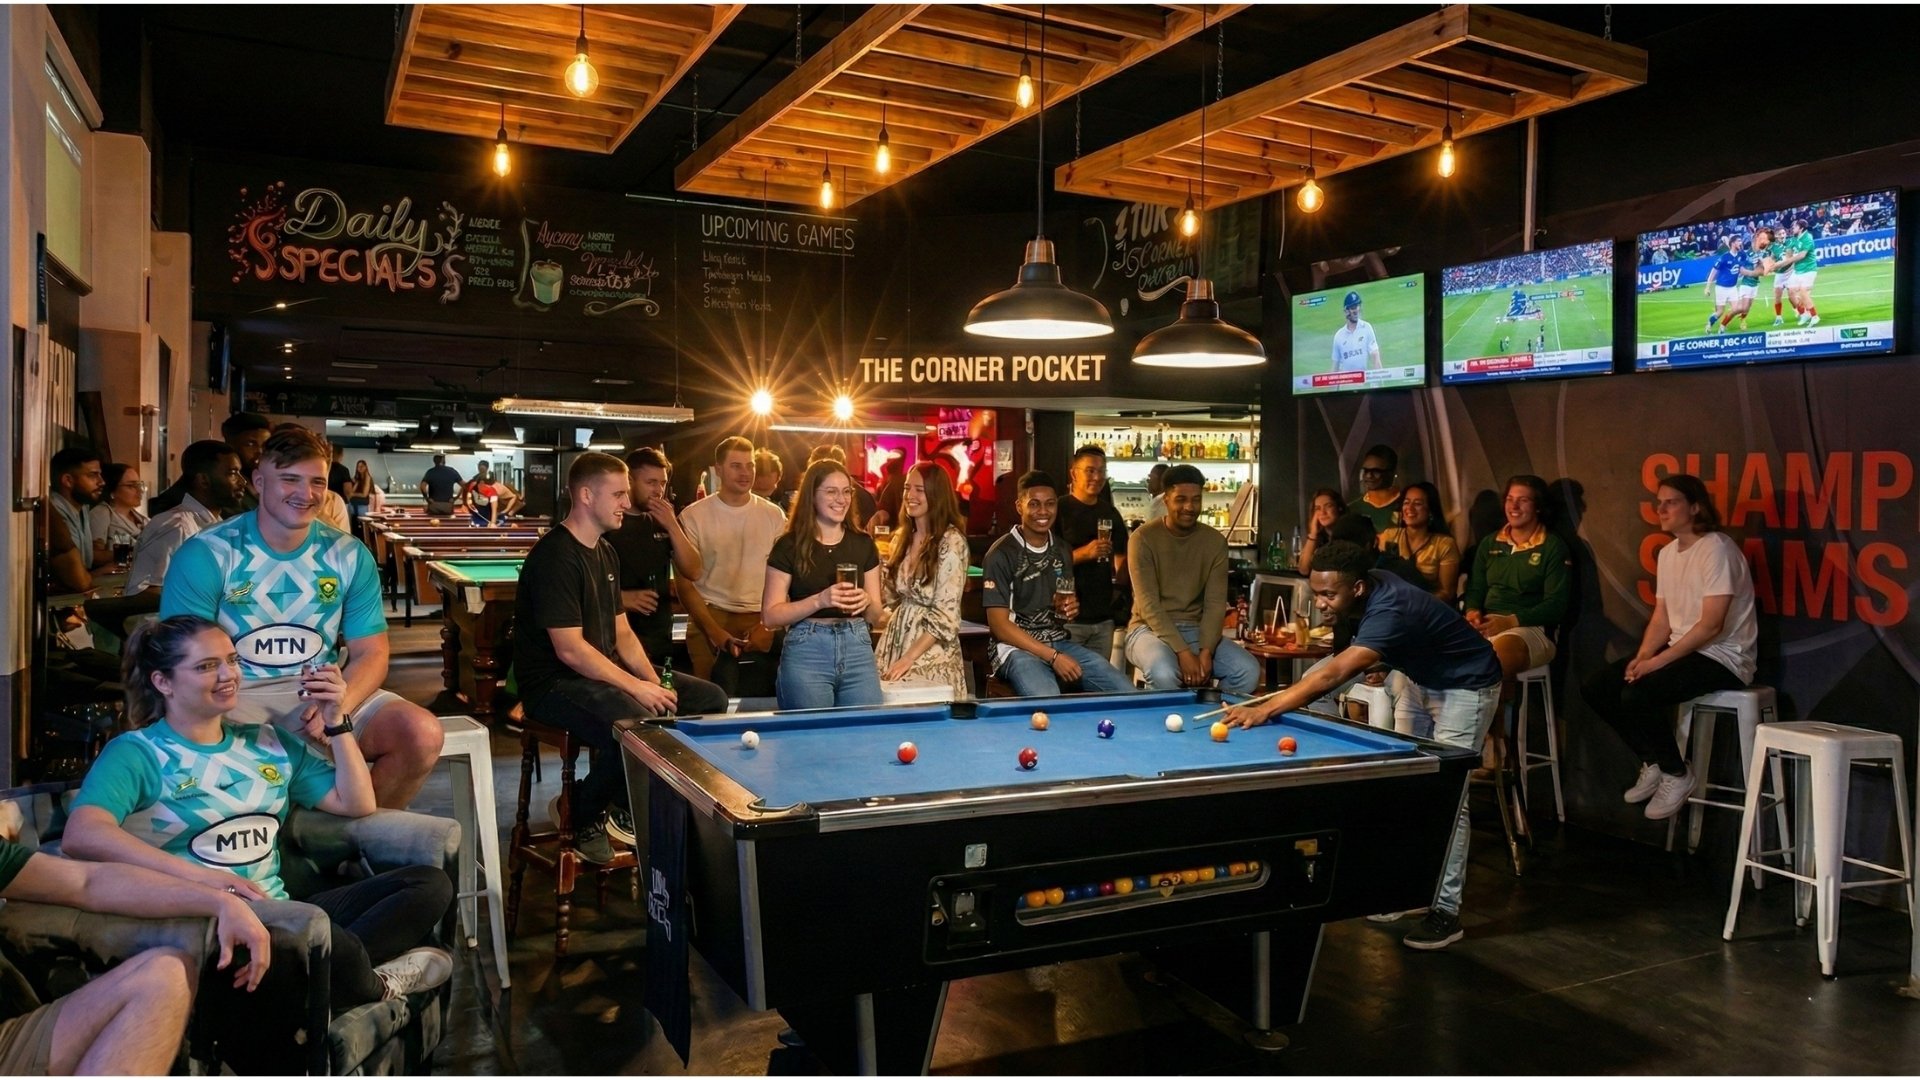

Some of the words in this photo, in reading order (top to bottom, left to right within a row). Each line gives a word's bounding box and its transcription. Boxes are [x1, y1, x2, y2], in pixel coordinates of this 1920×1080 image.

[284, 188, 443, 272] Daily
[702, 214, 789, 244] UPCOMING
[797, 223, 855, 250] GAMES
[279, 245, 437, 292] SPECIALS
[859, 358, 903, 383] THE
[910, 356, 1004, 383] CORNER
[1012, 355, 1106, 382] POCKET
[1640, 451, 1920, 532] SHAMP
[1637, 532, 1909, 627] SAMS
[254, 637, 306, 655] MTN
[216, 827, 268, 852] MTN
